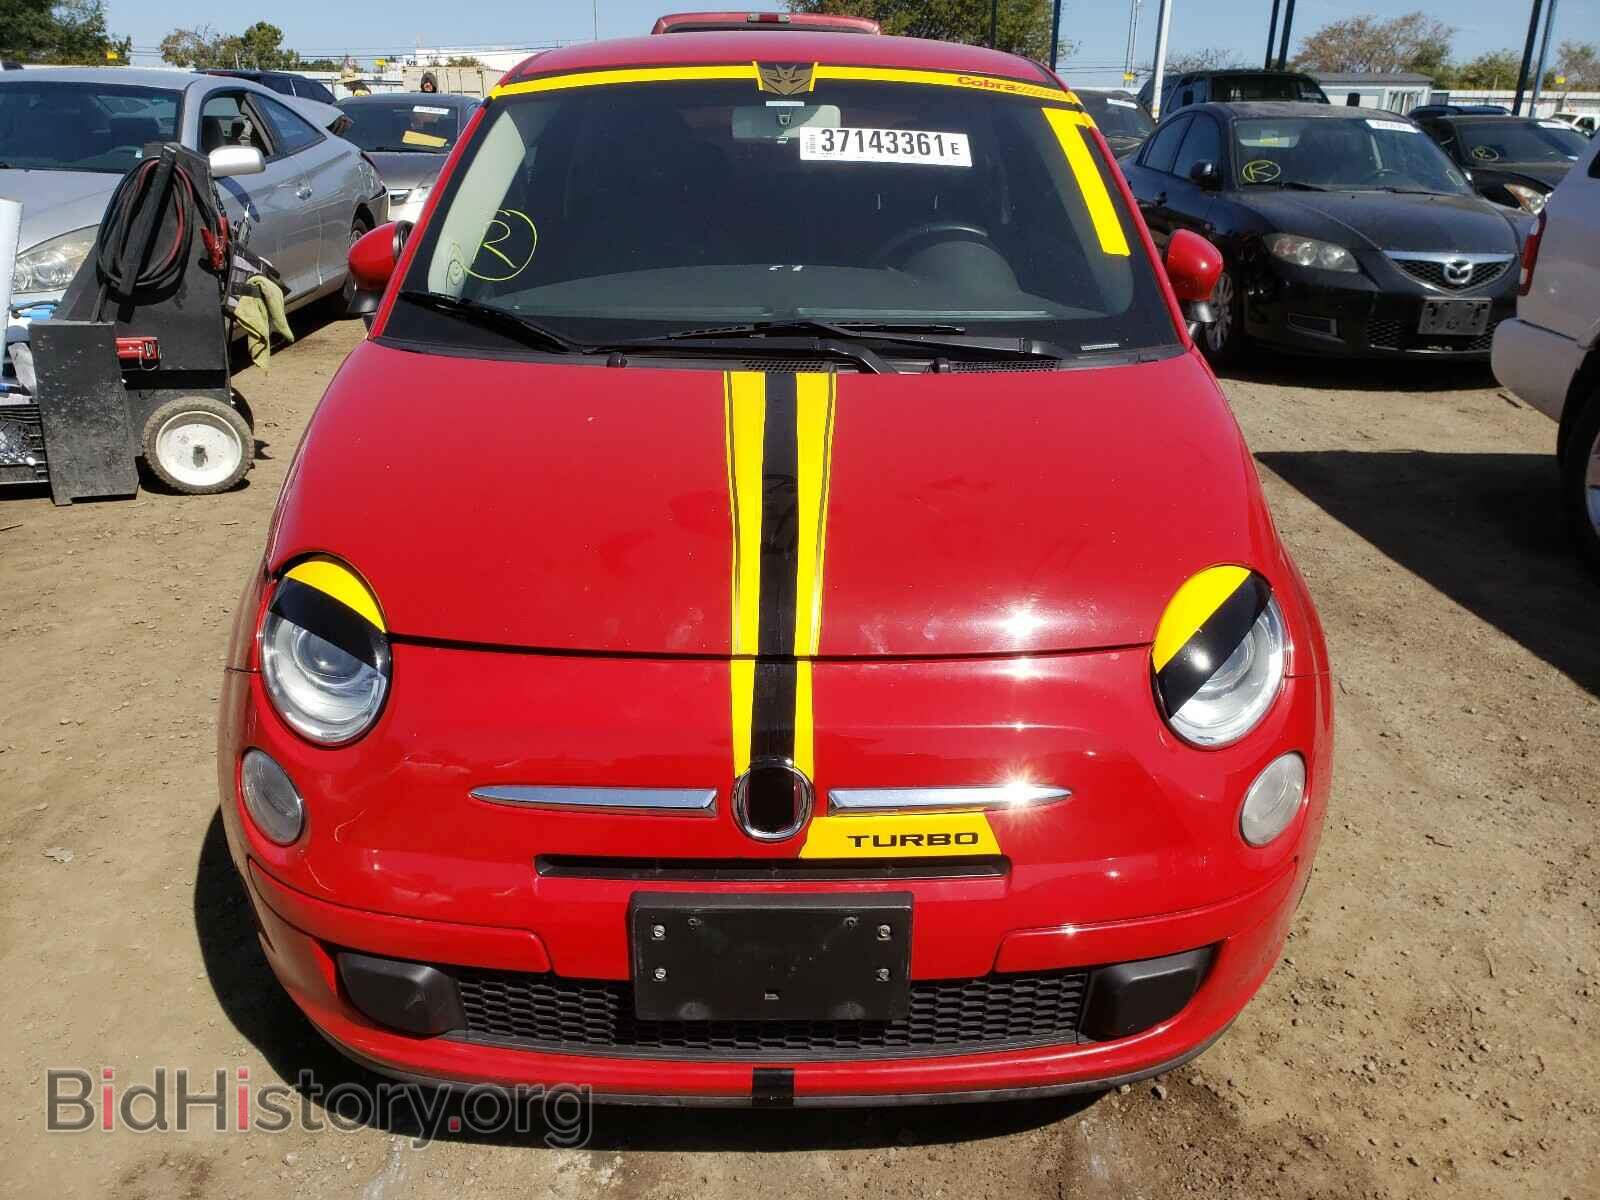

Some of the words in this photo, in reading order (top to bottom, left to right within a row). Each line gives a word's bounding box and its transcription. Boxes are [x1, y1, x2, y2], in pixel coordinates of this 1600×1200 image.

[957, 76, 1016, 91] Cobra
[821, 128, 944, 157] 37143361
[950, 142, 960, 156] E
[848, 832, 979, 848] TURBO
